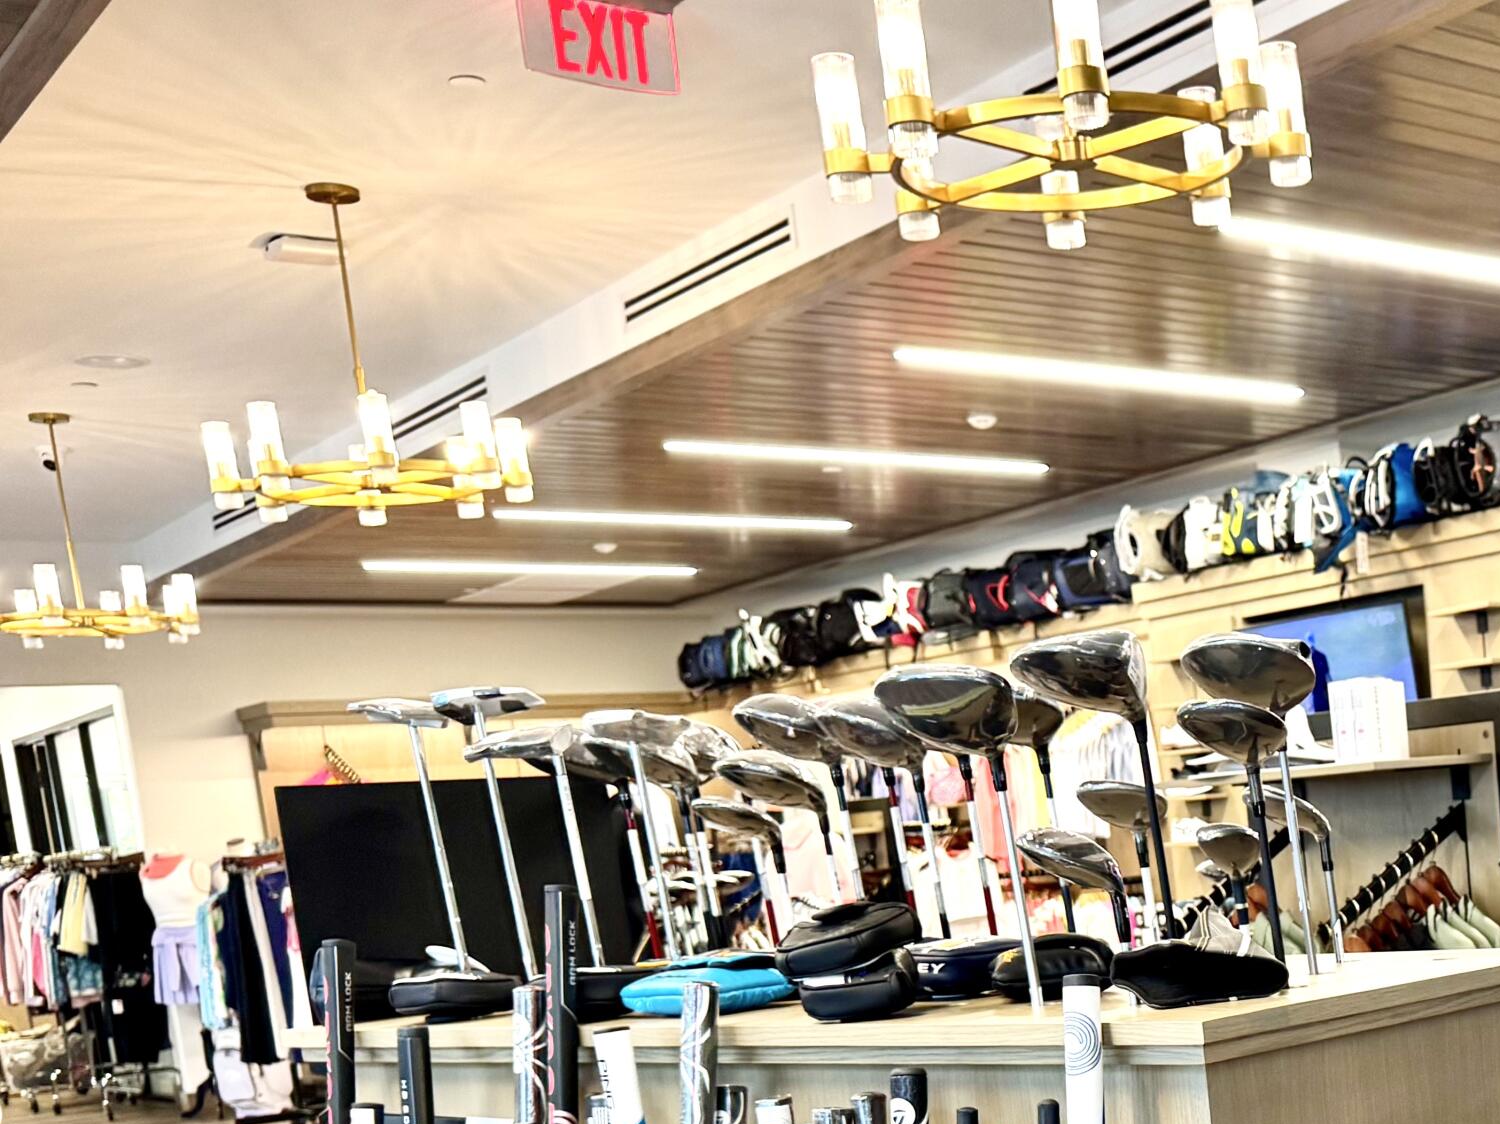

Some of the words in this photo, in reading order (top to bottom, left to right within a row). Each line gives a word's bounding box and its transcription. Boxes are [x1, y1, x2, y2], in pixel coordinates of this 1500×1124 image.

[549, 0, 653, 84] EXIT
[568, 920, 577, 953] LOCK
[344, 972, 353, 1002] LOCK
